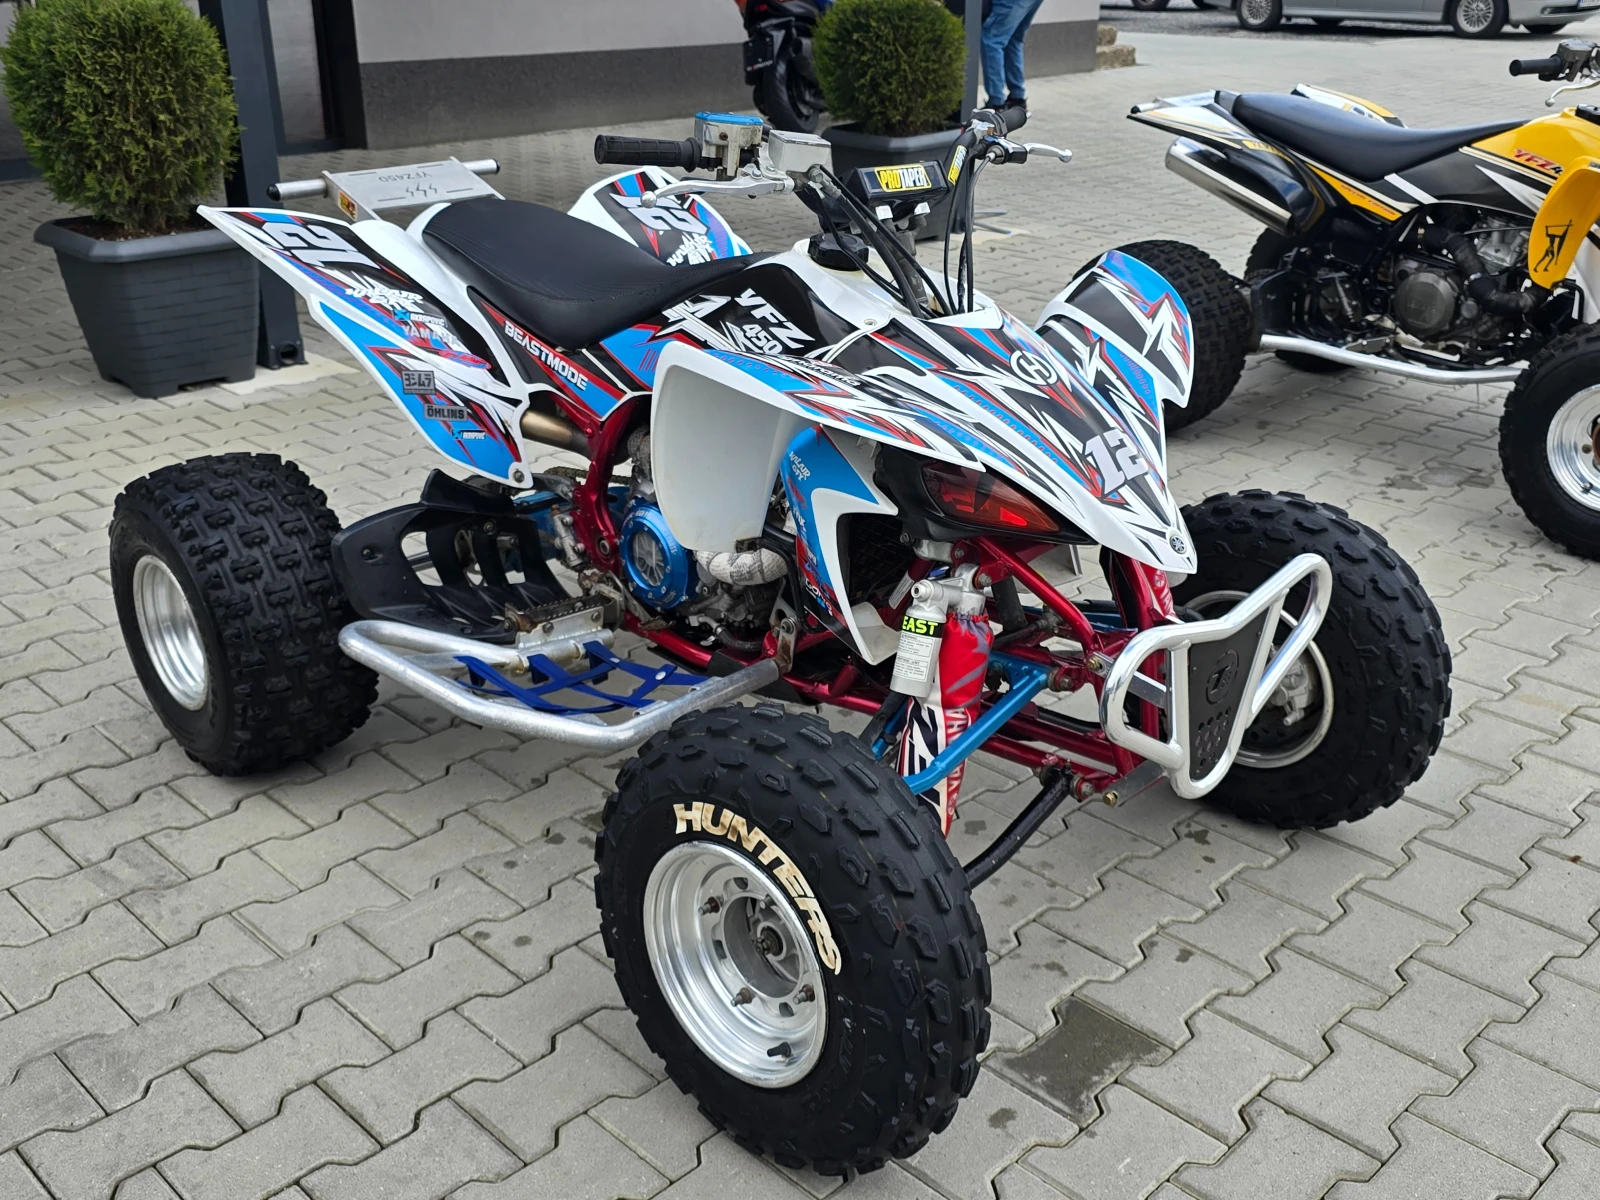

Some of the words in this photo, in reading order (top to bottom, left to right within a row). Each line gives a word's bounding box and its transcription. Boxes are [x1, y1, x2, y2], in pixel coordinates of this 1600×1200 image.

[377, 171, 433, 183] YFZ450
[734, 288, 816, 349] YFZ
[742, 324, 783, 355] 450
[504, 320, 589, 391] BEASTMODE
[427, 405, 466, 419] ÖHLINS
[1084, 427, 1150, 494] 12
[672, 801, 842, 976] HUNTERS
